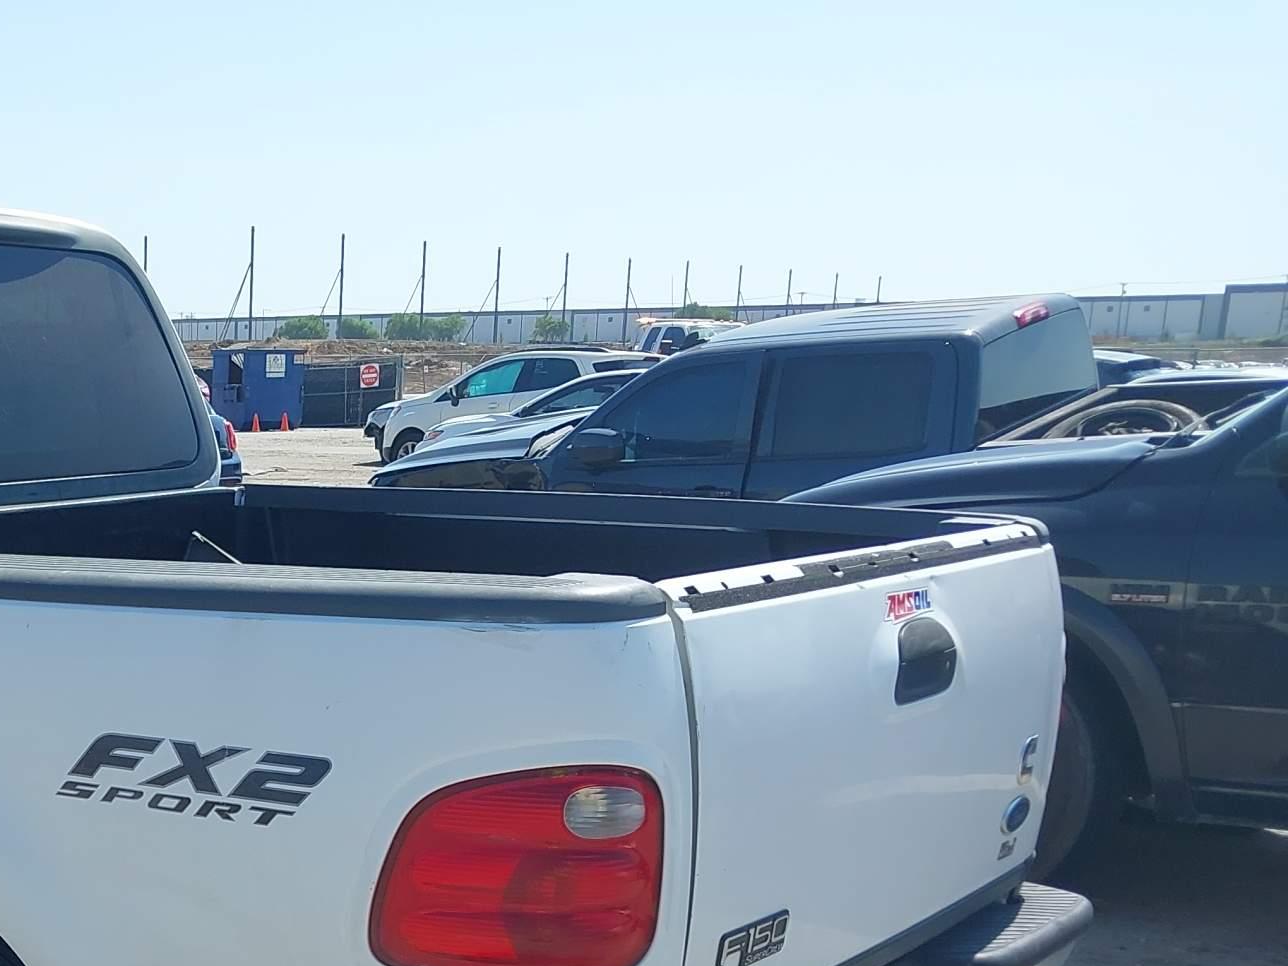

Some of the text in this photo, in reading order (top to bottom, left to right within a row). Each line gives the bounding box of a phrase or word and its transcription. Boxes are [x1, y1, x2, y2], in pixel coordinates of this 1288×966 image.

[886, 589, 931, 620] AMSOIL
[67, 733, 333, 808] FX2
[56, 780, 297, 826] SPORT
